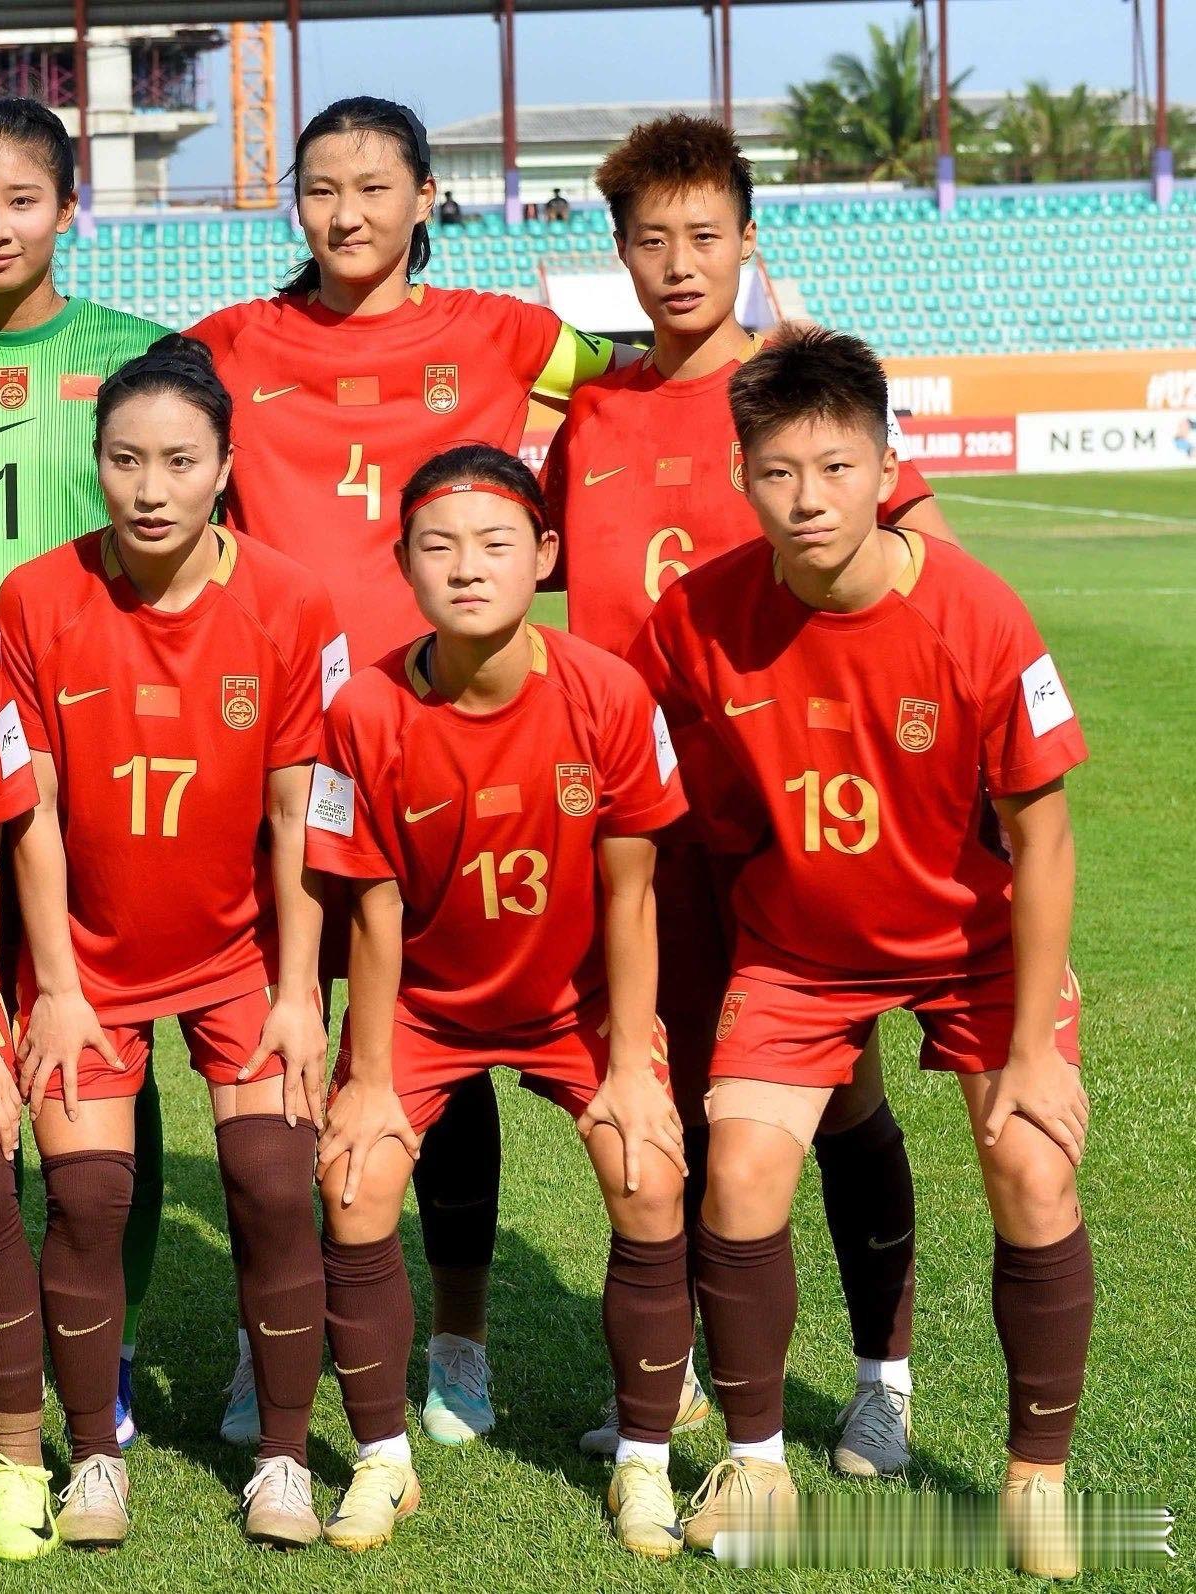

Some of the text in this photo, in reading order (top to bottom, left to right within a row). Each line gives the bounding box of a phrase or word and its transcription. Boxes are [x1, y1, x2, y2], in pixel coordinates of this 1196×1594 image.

[0, 368, 27, 377] CFA
[428, 368, 455, 378] CFA
[1050, 428, 1156, 452] NEOM
[336, 443, 381, 521] 4
[645, 527, 694, 602] 6
[326, 658, 345, 683] AFC
[225, 679, 256, 690] CFA
[1032, 680, 1056, 708] AFC
[903, 701, 936, 716] CFA
[560, 767, 590, 777] CFA
[112, 755, 198, 837] 17
[314, 809, 334, 819] ASIAN
[784, 770, 880, 855] 19
[462, 849, 549, 920] 13
